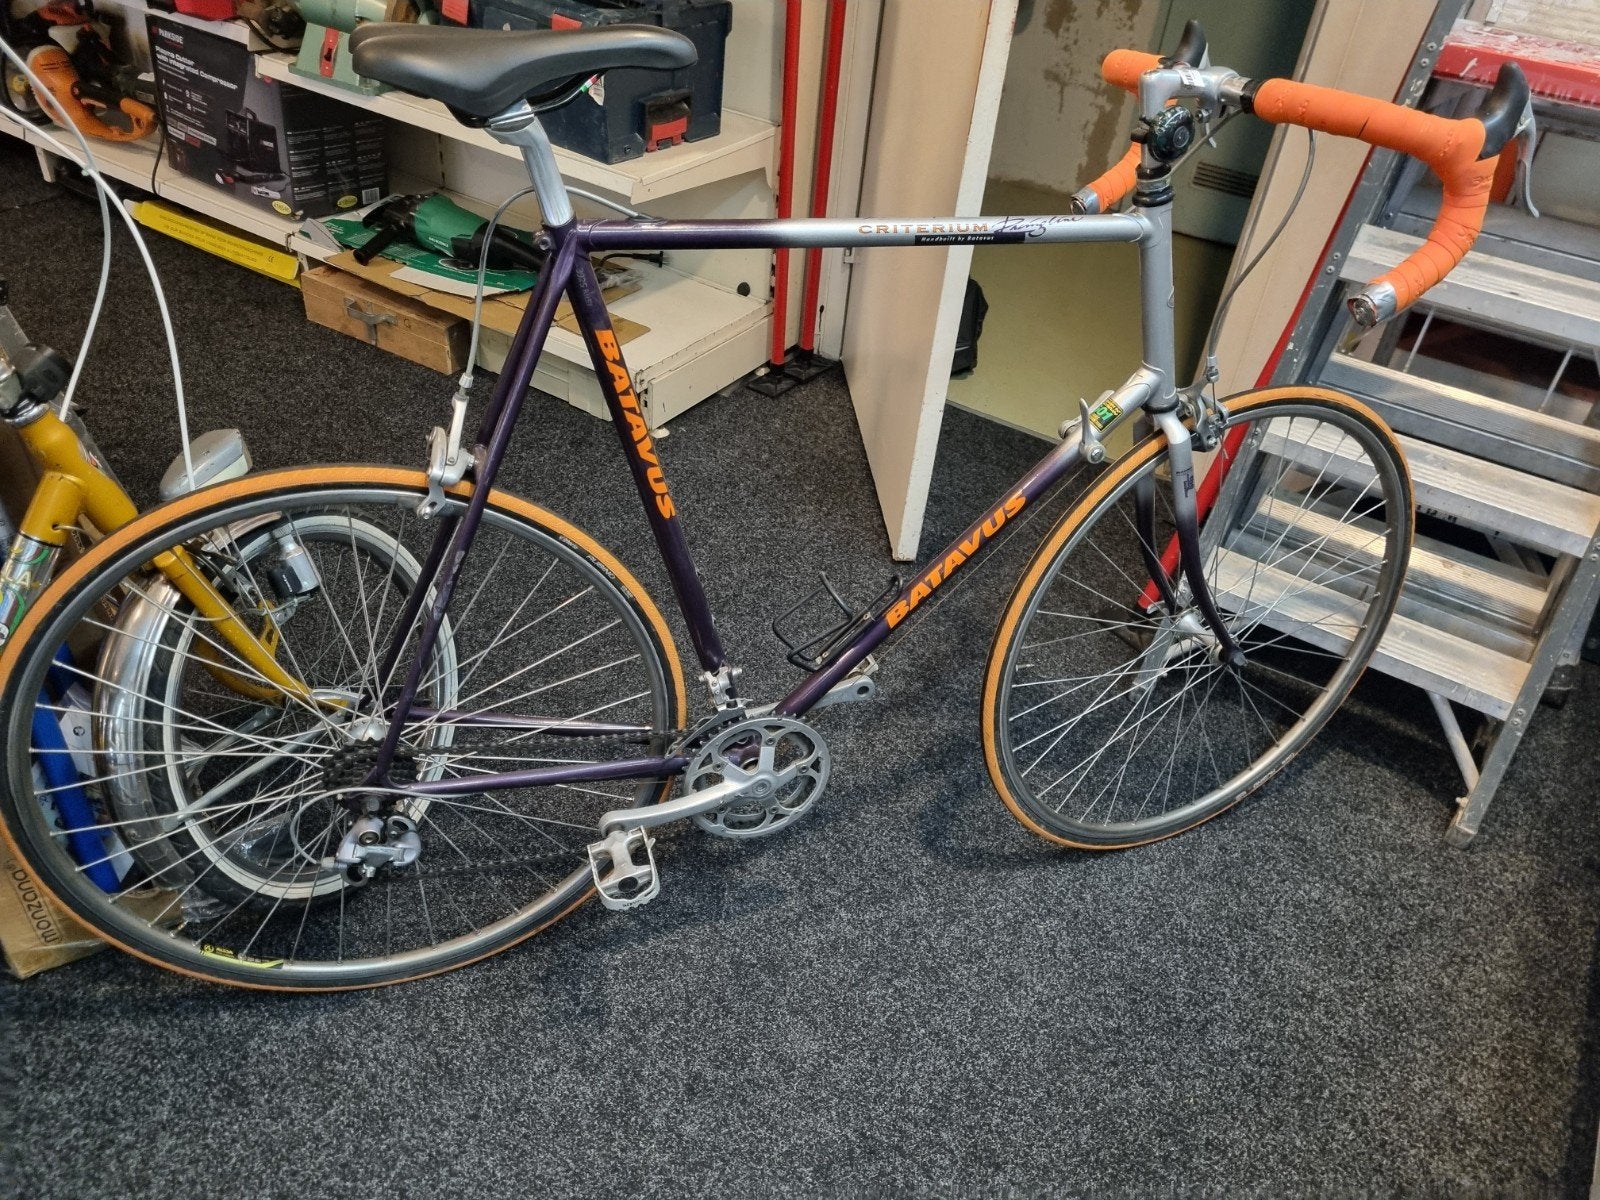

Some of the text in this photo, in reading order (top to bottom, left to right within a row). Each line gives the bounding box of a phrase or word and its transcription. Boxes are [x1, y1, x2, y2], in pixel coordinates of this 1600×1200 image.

[200, 70, 238, 90] Compressor
[858, 223, 989, 235] CRITERIUM
[594, 329, 676, 520] BATAVUS
[884, 494, 1027, 630] BATAVUS
[13, 868, 62, 943] monzana
